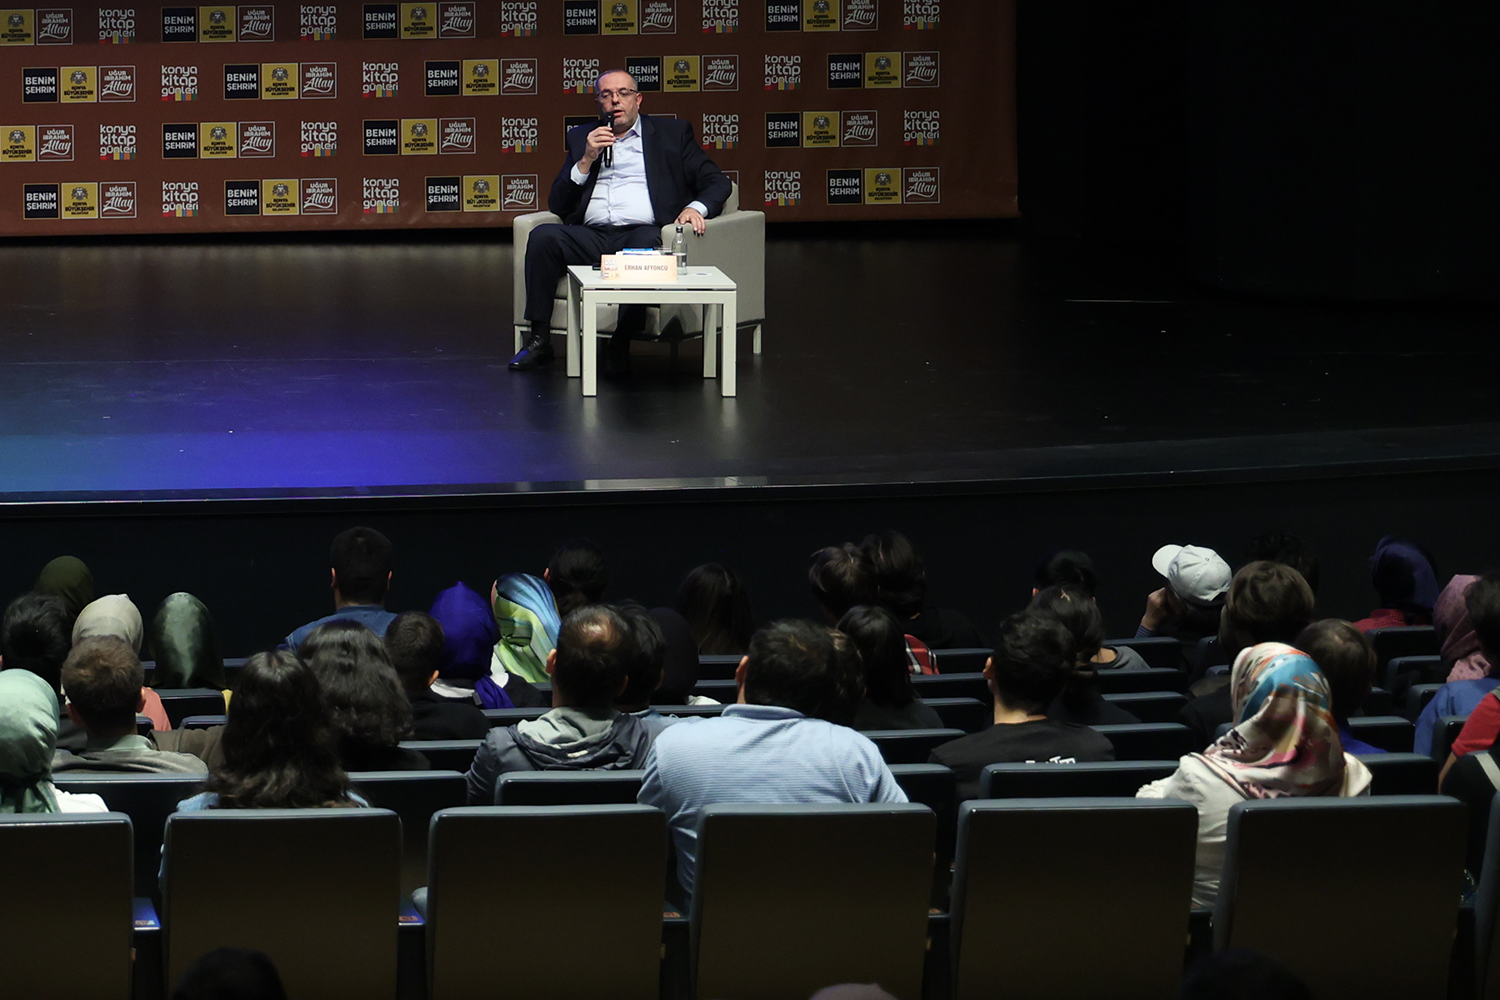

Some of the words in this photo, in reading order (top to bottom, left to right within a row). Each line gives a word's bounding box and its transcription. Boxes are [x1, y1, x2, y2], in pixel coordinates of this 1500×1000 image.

[300, 5, 336, 16] konya
[702, 7, 739, 18] kitap
[300, 15, 336, 26] kitap
[362, 62, 398, 73] konya
[362, 72, 398, 83] kitap
[764, 170, 801, 182] konya
[764, 180, 801, 191] kitap
